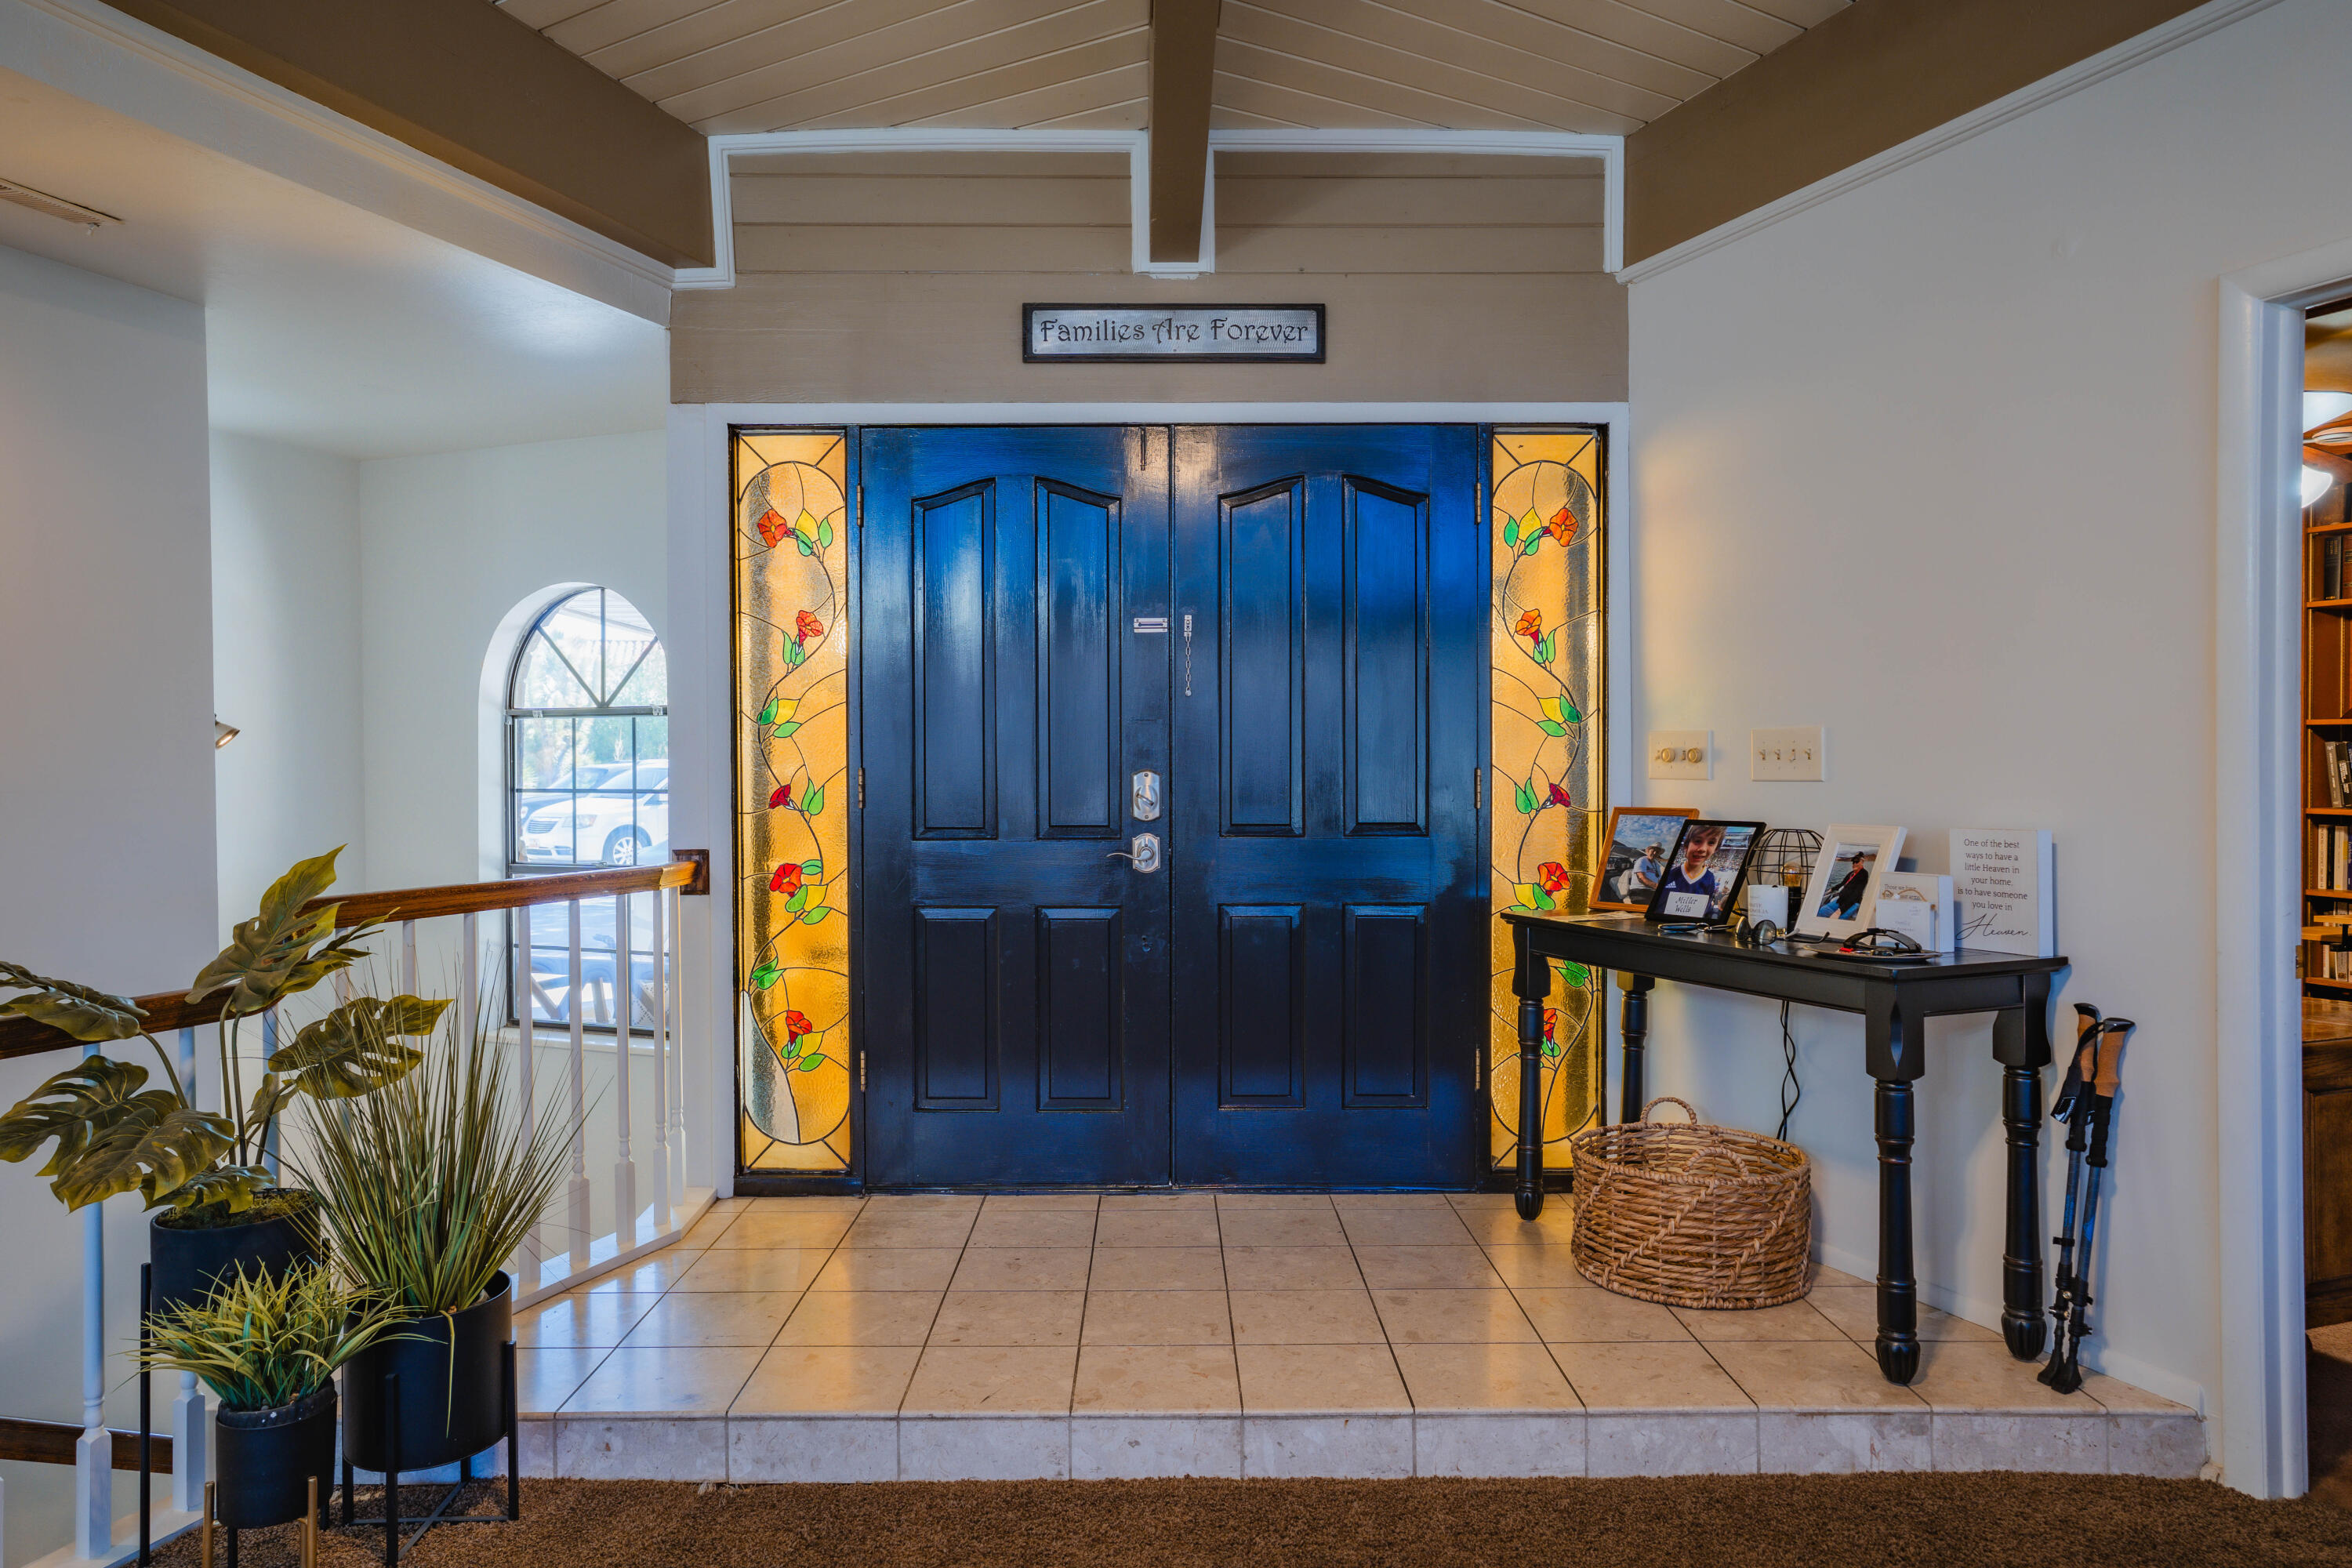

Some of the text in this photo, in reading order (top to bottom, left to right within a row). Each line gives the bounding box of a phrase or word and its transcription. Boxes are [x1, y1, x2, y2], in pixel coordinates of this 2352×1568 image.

[1040, 317, 1308, 344] Families Are Forever
[1964, 838, 1980, 847] One
[1990, 840, 2002, 848] the
[2004, 840, 2020, 849] best
[1965, 853, 1984, 862] ways
[1994, 852, 2013, 861] have
[1965, 862, 2020, 874] little Heaven in
[1971, 877, 1987, 886] your
[1957, 887, 1964, 895] is
[1974, 887, 1991, 897] have
[1993, 891, 2028, 900] someone
[1675, 896, 1698, 905] Miller
[1987, 901, 2003, 911] love
[2005, 902, 2013, 911] in
